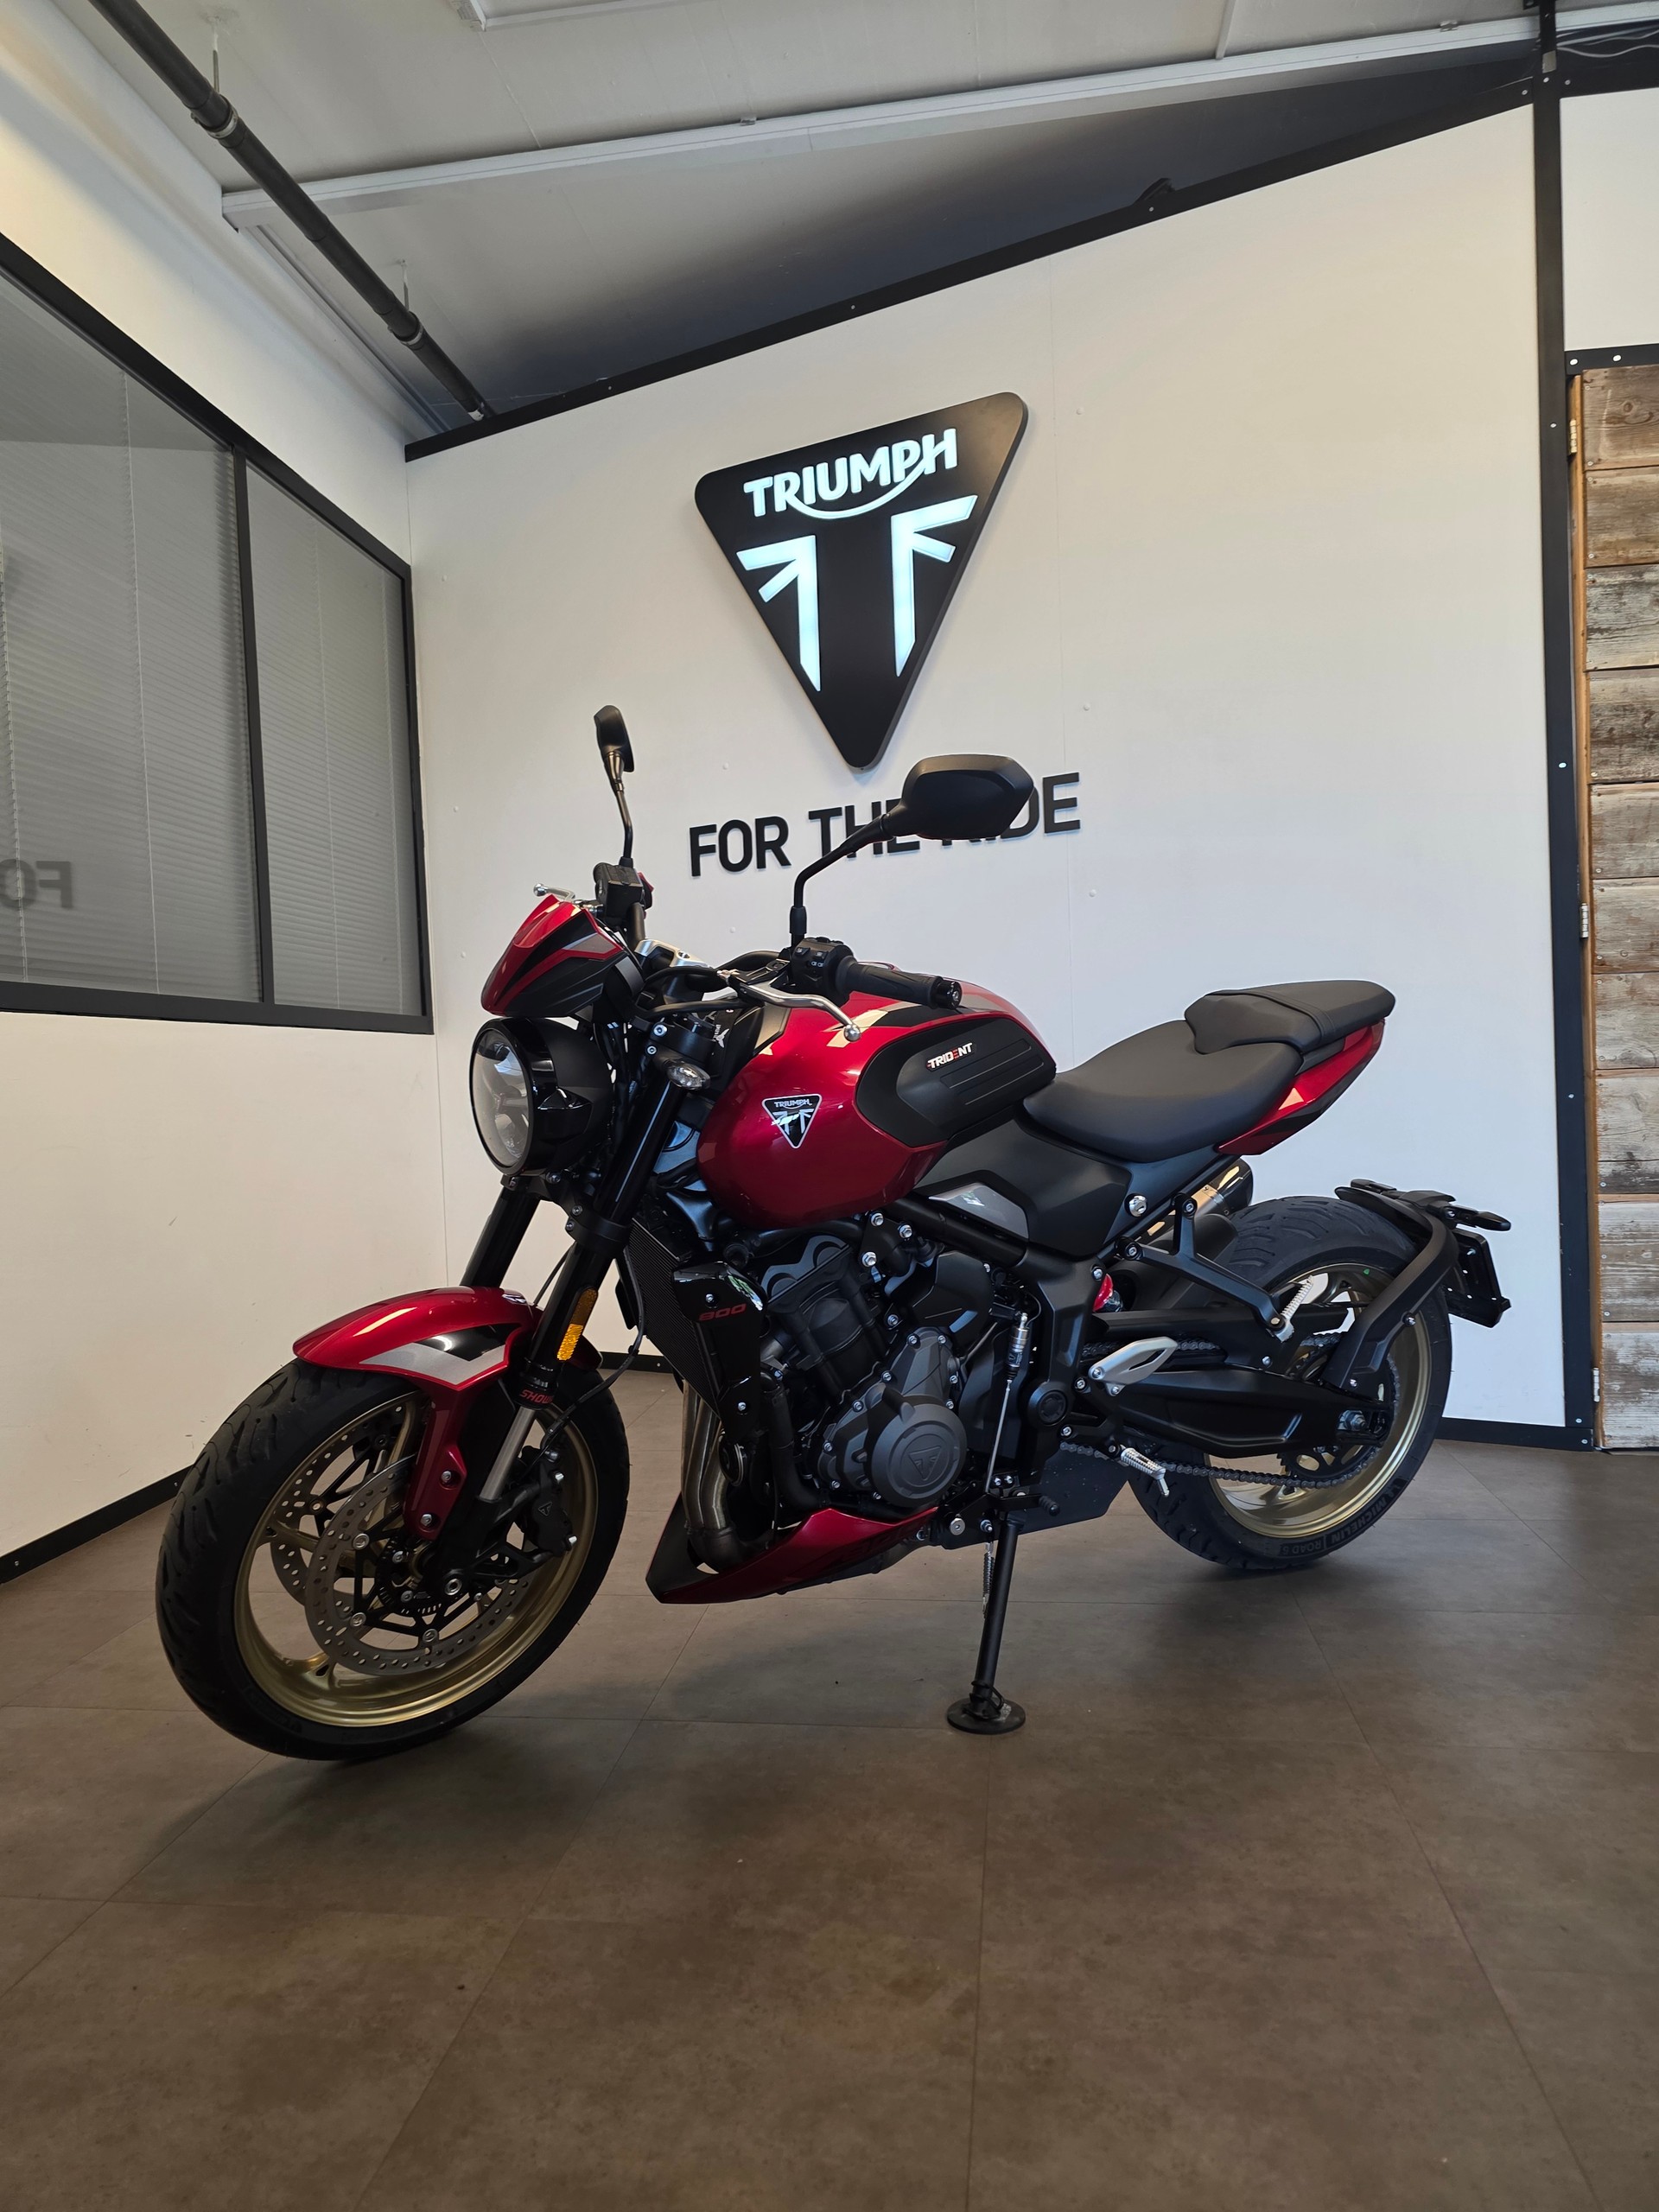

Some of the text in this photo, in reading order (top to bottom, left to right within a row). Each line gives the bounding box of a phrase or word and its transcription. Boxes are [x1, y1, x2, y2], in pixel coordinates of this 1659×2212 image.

[743, 428, 957, 519] TRIUMPH
[690, 817, 792, 876] FOR
[927, 1042, 973, 1069] TRIDENT
[774, 1098, 810, 1109] TRIUMPH
[698, 1302, 747, 1322] 800
[519, 1389, 554, 1405] SHOW
[1332, 1499, 1387, 1543] MICHELIN
[1293, 1540, 1322, 1554] ROAD
